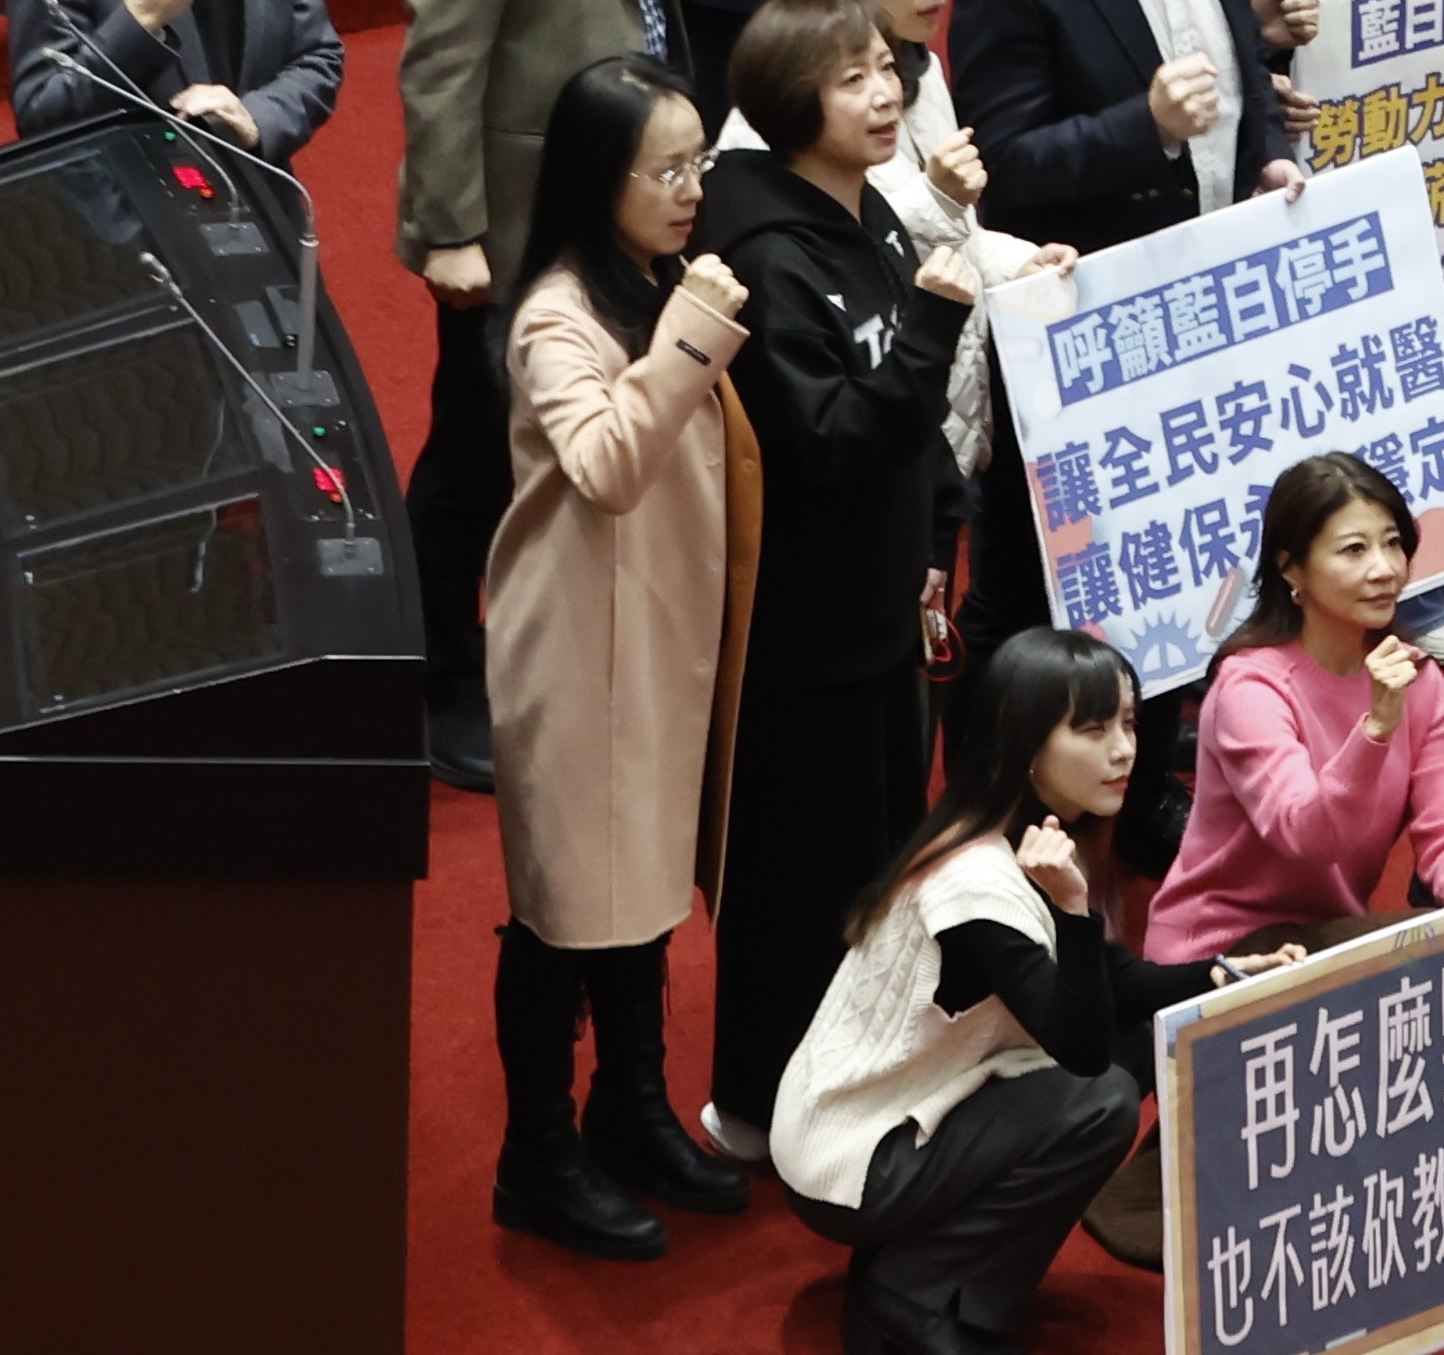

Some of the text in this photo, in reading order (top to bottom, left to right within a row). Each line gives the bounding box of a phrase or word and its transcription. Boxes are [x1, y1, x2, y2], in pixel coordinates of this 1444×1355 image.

[1055, 218, 1387, 393] 呼籲藍白停手
